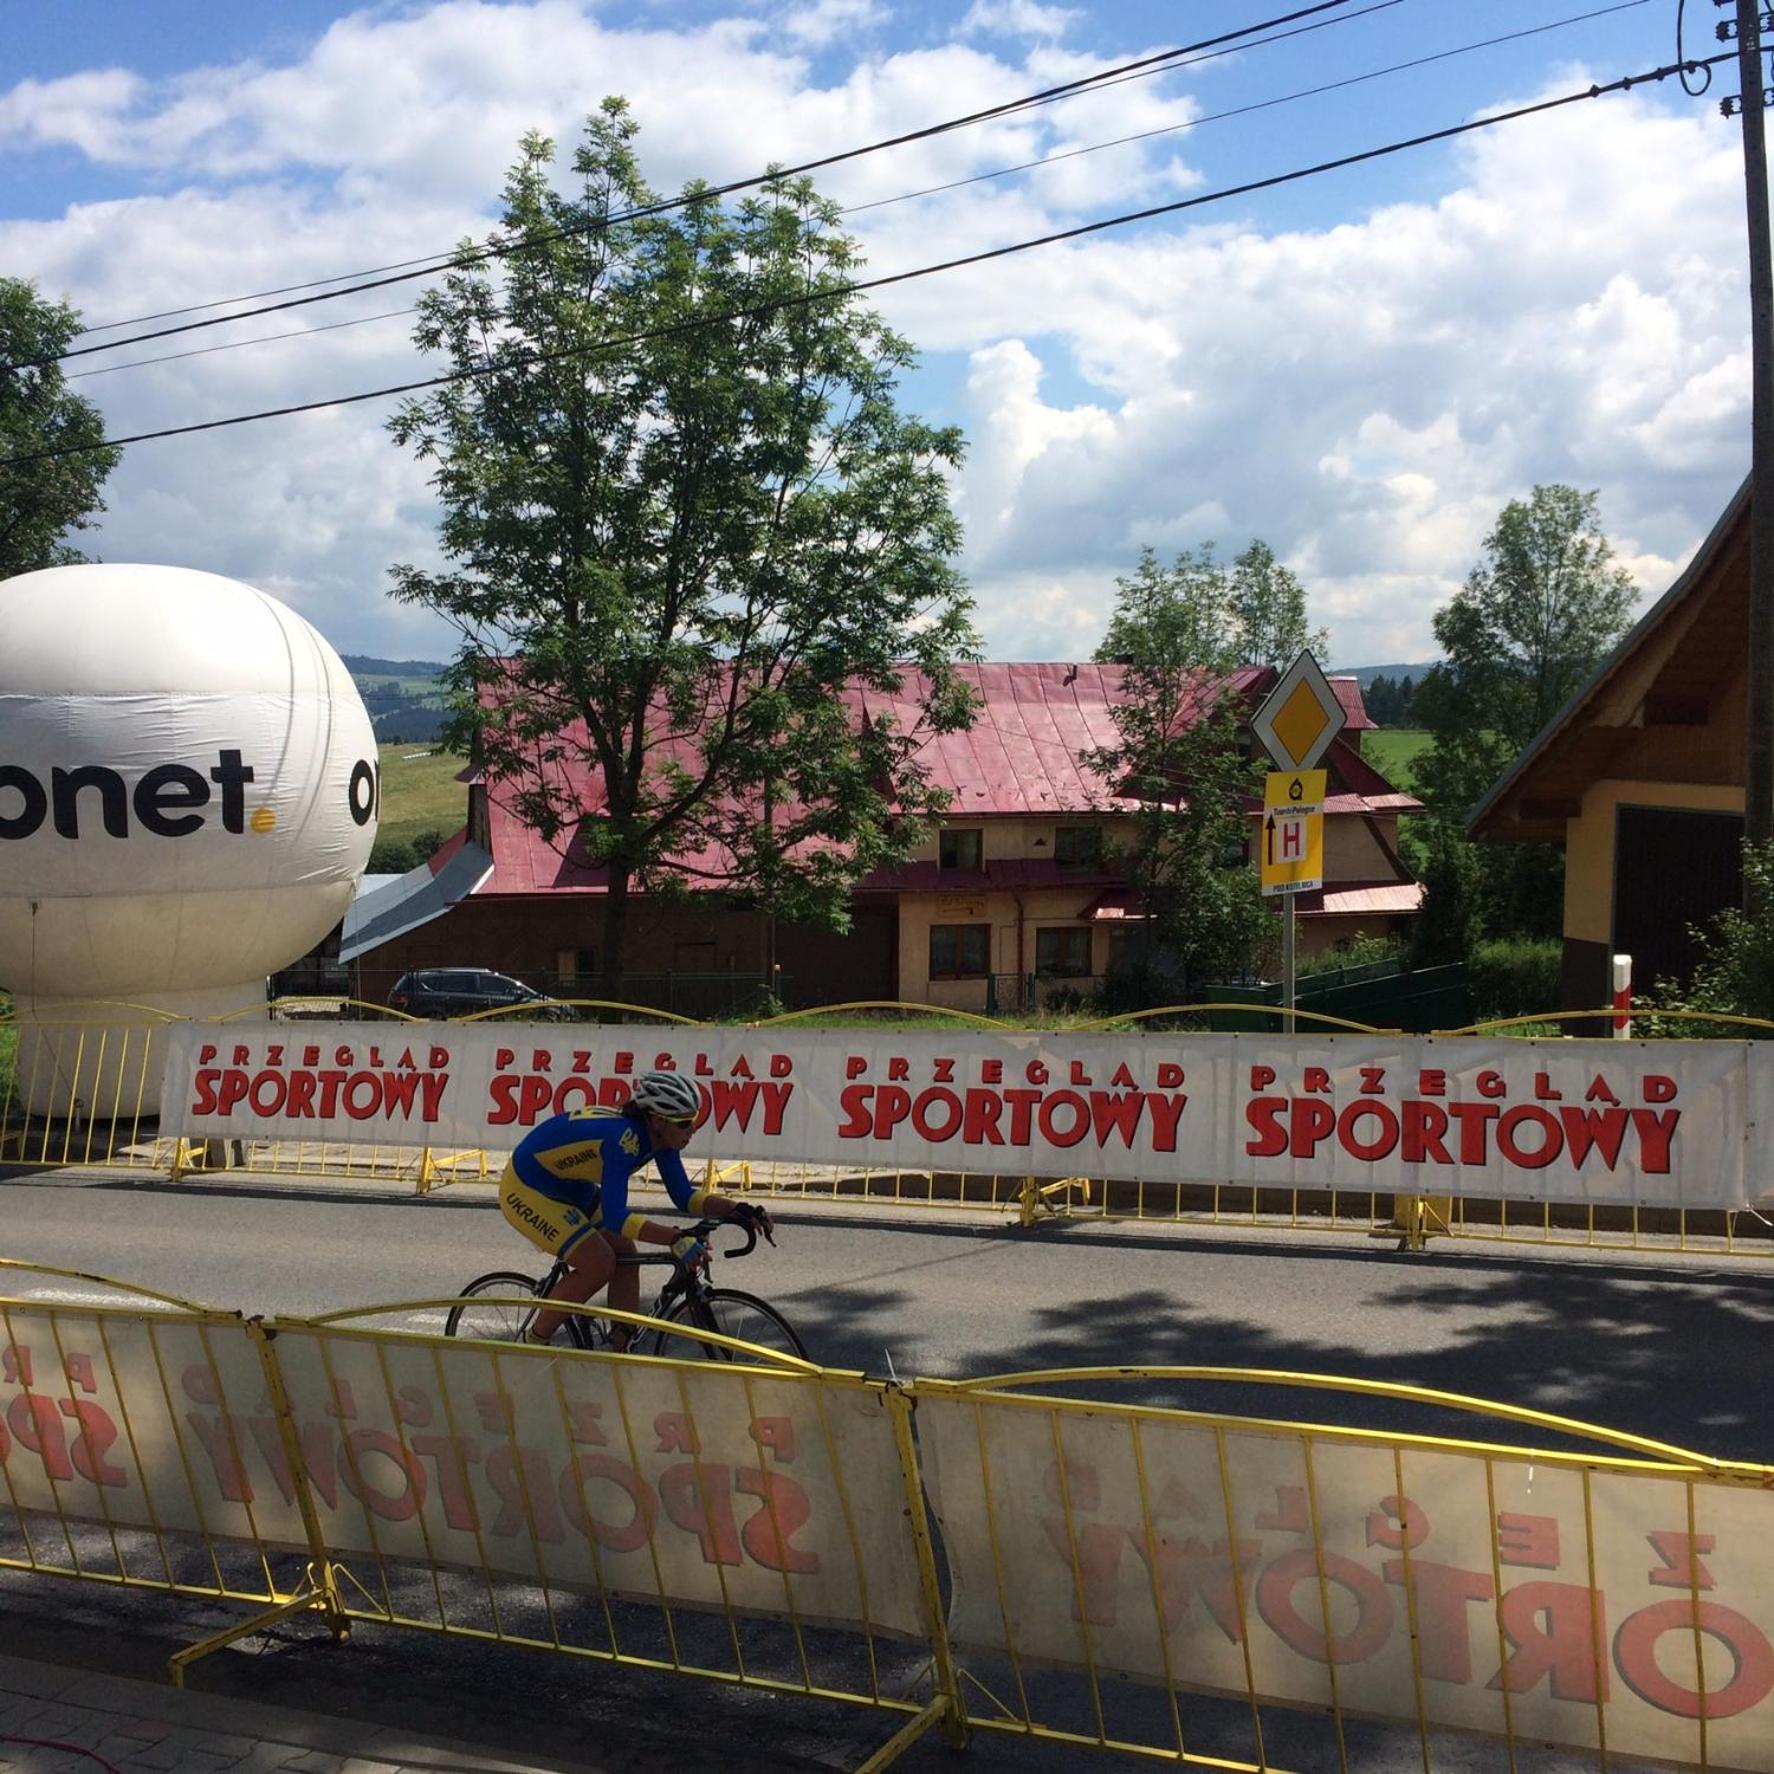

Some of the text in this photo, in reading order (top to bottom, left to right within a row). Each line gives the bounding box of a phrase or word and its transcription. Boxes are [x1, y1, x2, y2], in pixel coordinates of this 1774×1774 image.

[1283, 821, 1300, 857] H
[192, 1069, 449, 1122] SPORTOWY
[838, 1084, 1188, 1152] SPORTOWY
[555, 1148, 598, 1172] UKRAINE
[1245, 1097, 1680, 1174] SPORTOWY
[506, 1192, 560, 1243] UKRAINE
